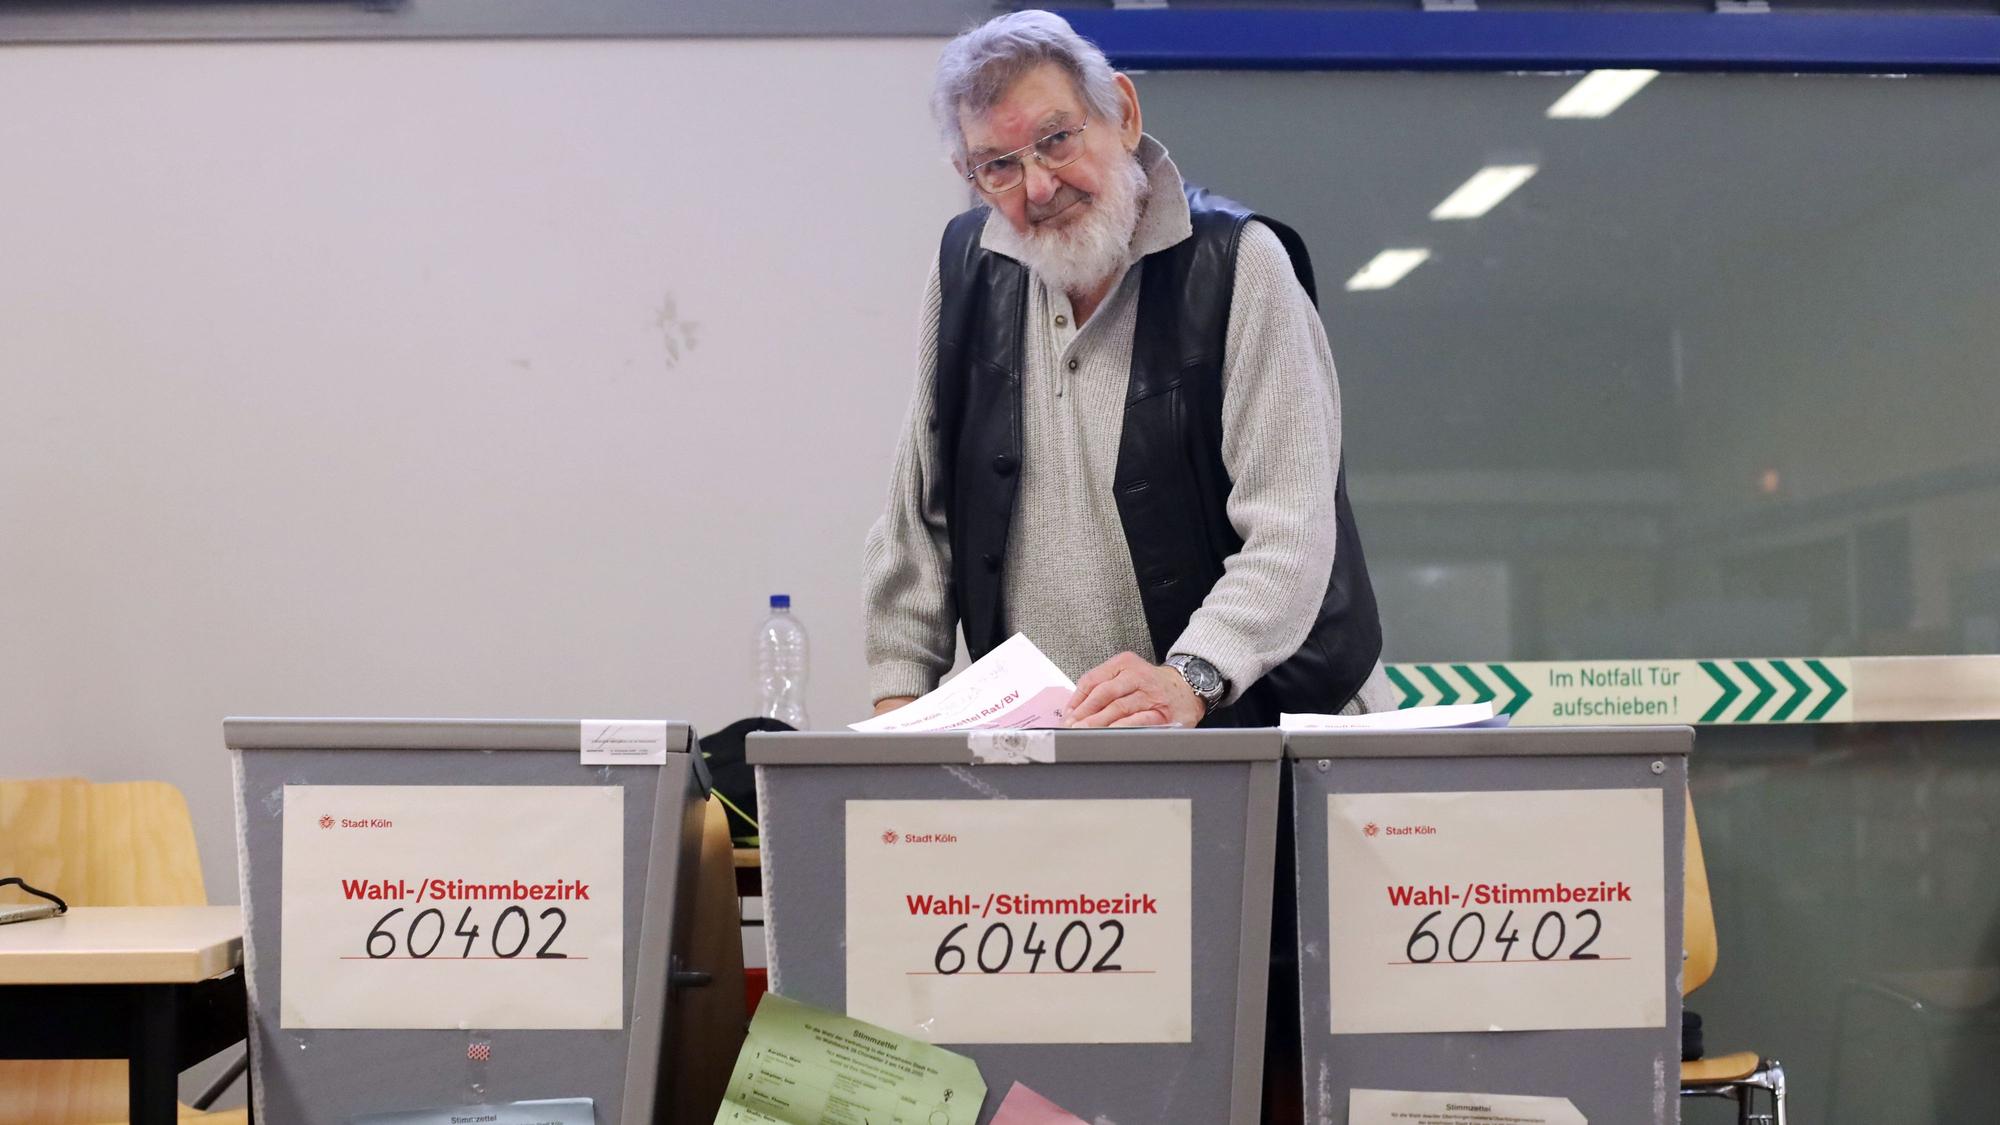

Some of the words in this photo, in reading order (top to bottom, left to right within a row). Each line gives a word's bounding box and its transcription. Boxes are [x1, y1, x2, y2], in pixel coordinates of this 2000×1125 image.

[1549, 668, 1574, 687] Im
[1580, 667, 1643, 687] Notfall
[1648, 666, 1681, 686] Tür
[981, 689, 1020, 717] Rat/BV
[1552, 697, 1668, 717] aufschieben
[341, 818, 369, 829] Stadt
[370, 817, 393, 829] Köln
[1385, 825, 1412, 836] Stadt
[1414, 824, 1437, 835] Köln
[905, 833, 933, 843] Stadt
[934, 831, 957, 843] Köln
[341, 878, 590, 904] Wahl-/Stimmbezirk
[1387, 881, 1632, 908] Wahl-/Stimmbezirk
[905, 892, 1158, 918] Wahl-/Stimmbezirk
[366, 905, 568, 959] 60402
[1406, 908, 1602, 963] 60402
[934, 918, 1125, 975] 60402
[853, 1030, 898, 1051] Stimmzettel
[1446, 1103, 1492, 1113] Stimmzettel
